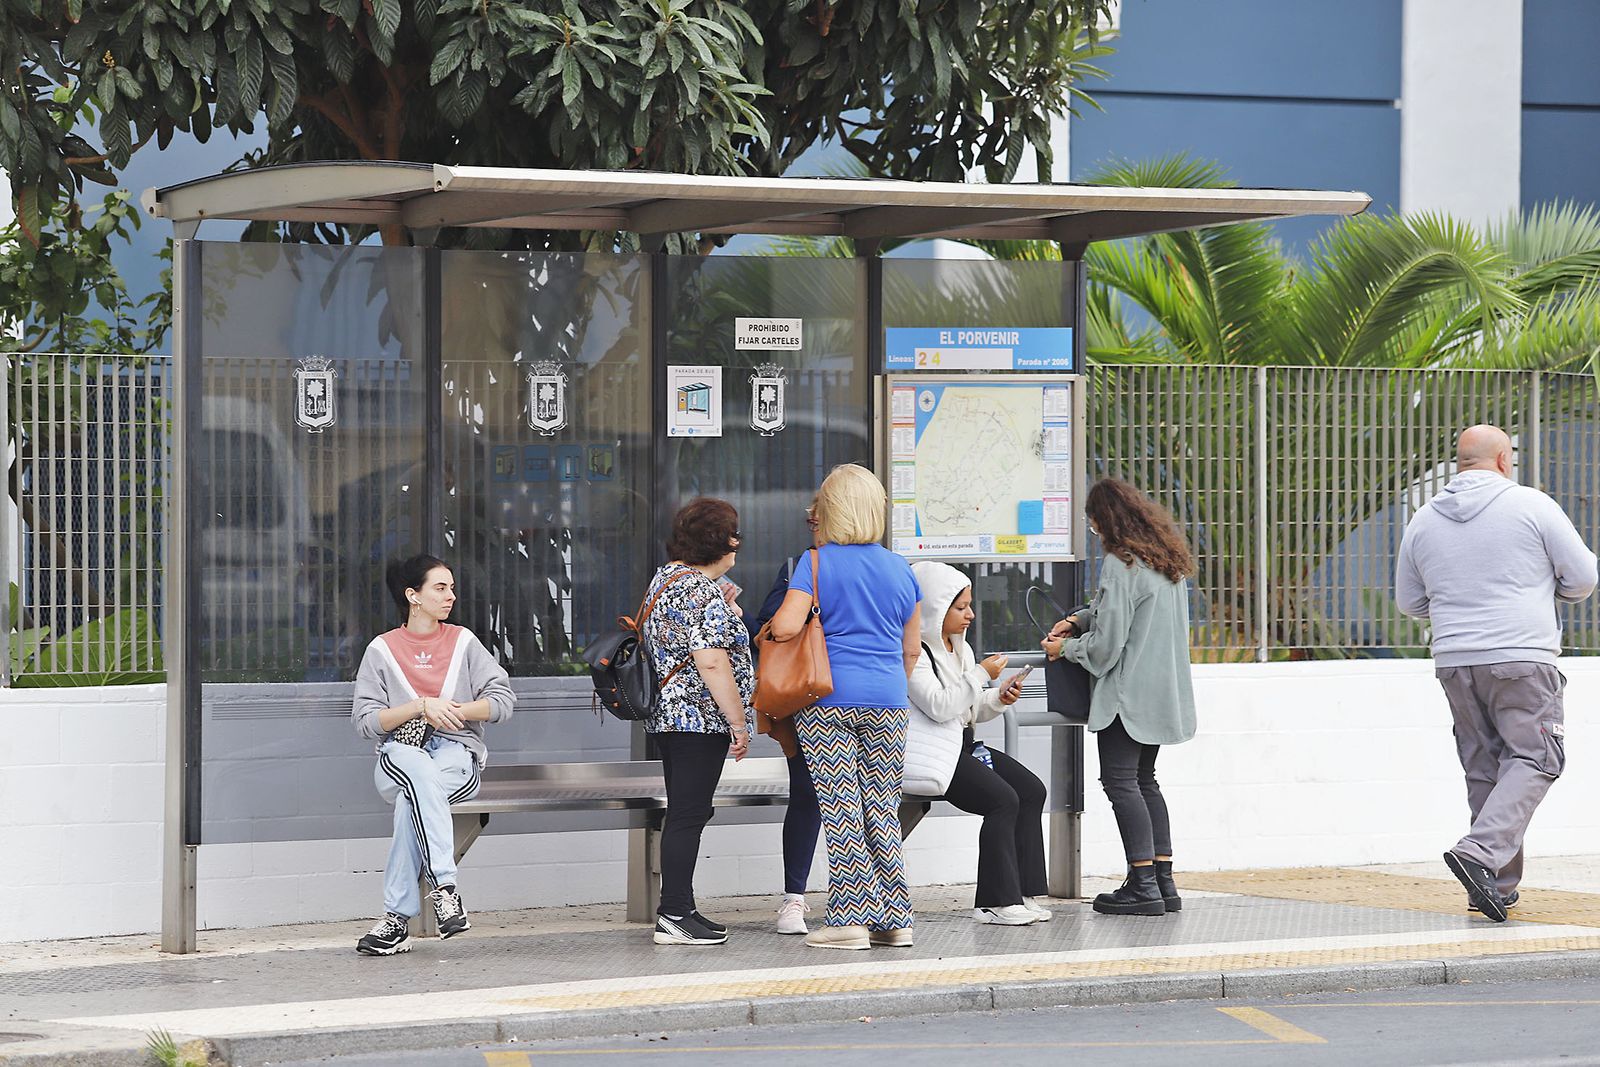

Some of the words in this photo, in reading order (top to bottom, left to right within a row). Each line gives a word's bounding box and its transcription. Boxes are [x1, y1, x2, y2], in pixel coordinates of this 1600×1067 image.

[748, 324, 790, 332] PROHIBIDO
[761, 337, 800, 345] CARTELES
[939, 331, 955, 345] EL
[958, 331, 1020, 345] PORVENIR
[918, 352, 927, 366] 2
[932, 352, 941, 366] 4
[1017, 358, 1042, 366] Parada
